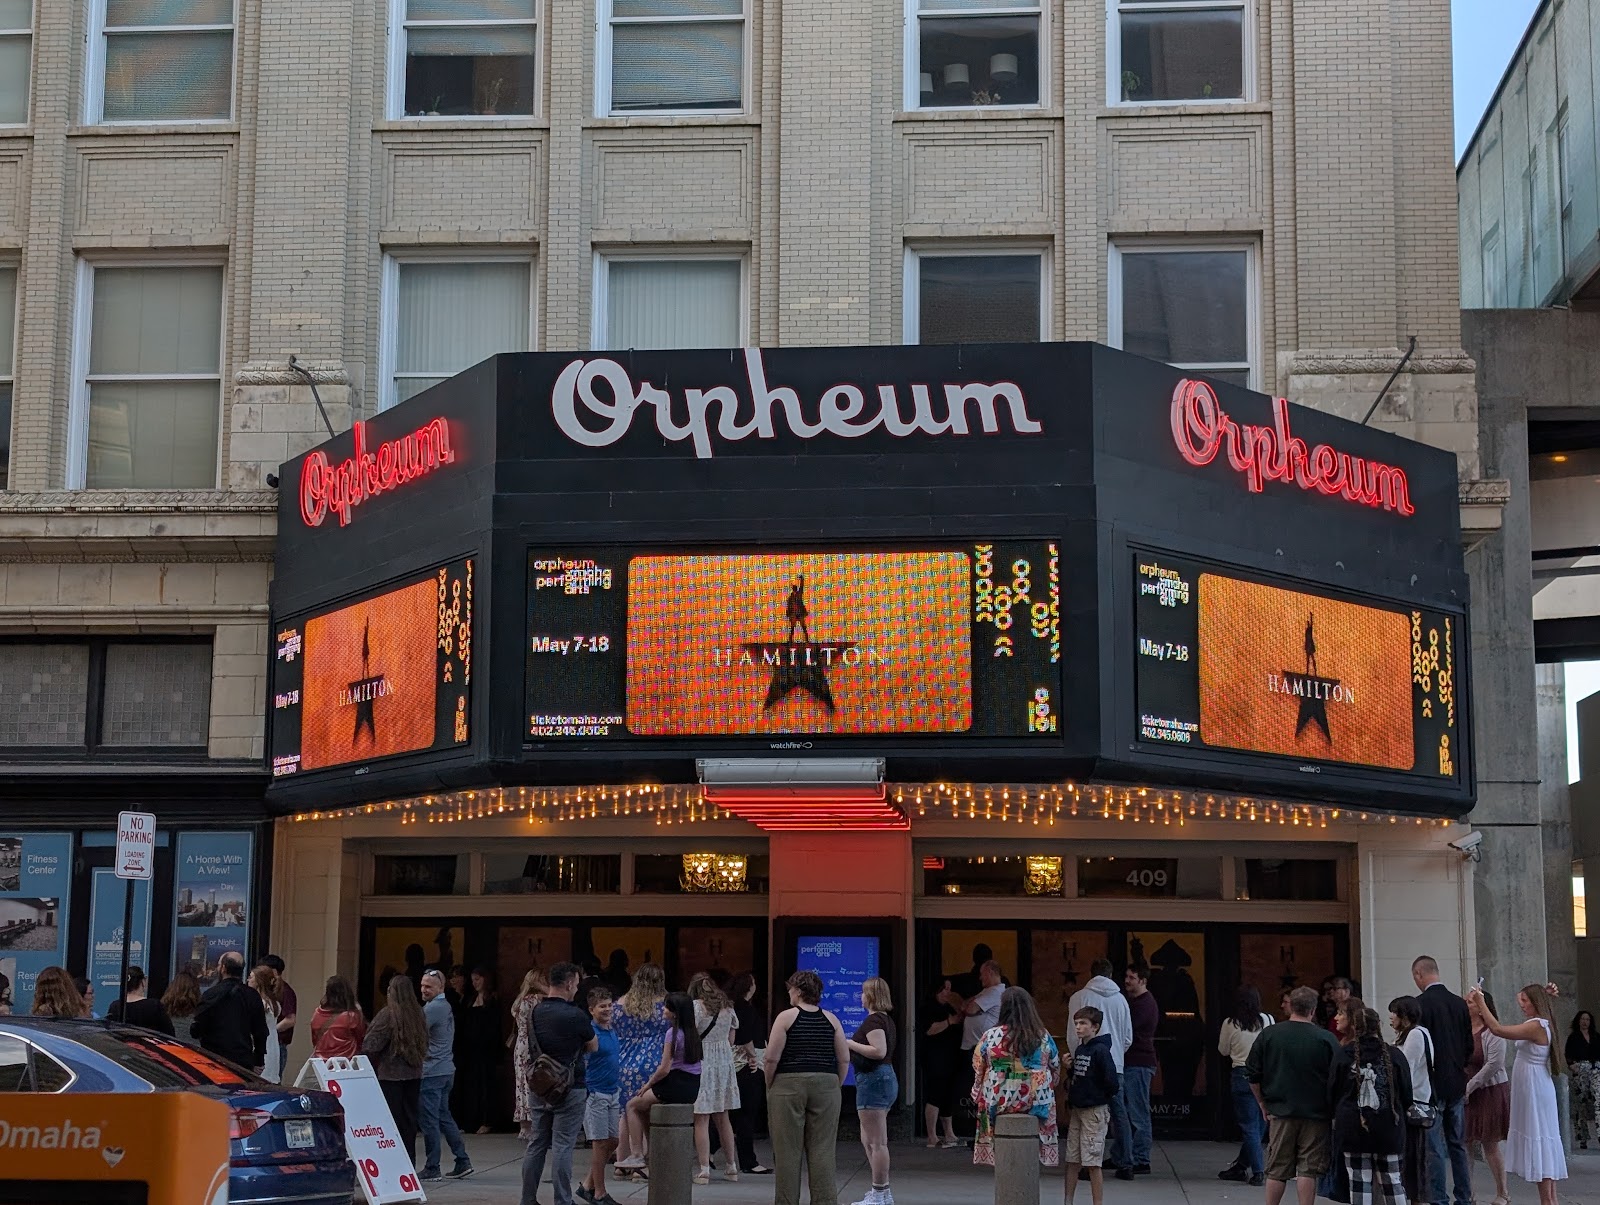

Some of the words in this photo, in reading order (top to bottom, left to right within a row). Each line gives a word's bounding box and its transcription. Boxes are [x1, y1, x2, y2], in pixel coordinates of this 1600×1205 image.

[551, 346, 1043, 459] Orpheum
[1170, 378, 1415, 517] Orpheum
[299, 416, 455, 528] Orpheum
[533, 556, 595, 574] orpheum
[1139, 562, 1179, 580] orpheum
[532, 636, 569, 655] May
[573, 636, 610, 652] 7-18
[1140, 638, 1165, 661] May
[1165, 642, 1190, 662] 7-18
[713, 647, 888, 667] HAMILTON
[338, 677, 394, 707] HAMILTON
[1268, 673, 1355, 704] HAMILTON
[530, 714, 623, 725] ticketomaha.com
[770, 741, 801, 749] watchfire
[130, 817, 144, 830] NO
[120, 830, 152, 844] PARKING
[27, 855, 58, 864] Fitness
[124, 850, 146, 859] LOADING
[186, 855, 194, 864] A
[195, 855, 221, 864] Home
[223, 855, 243, 864] With
[27, 865, 57, 875] Center
[127, 859, 142, 867] ZONE
[197, 866, 206, 875] A
[206, 866, 231, 875] View!
[1126, 869, 1168, 887] 409
[801, 945, 842, 955] performing
[1149, 1104, 1171, 1114] MAY
[1172, 1104, 1190, 1114] 7-18
[350, 1124, 385, 1139] loading
[376, 1138, 396, 1150] zone
